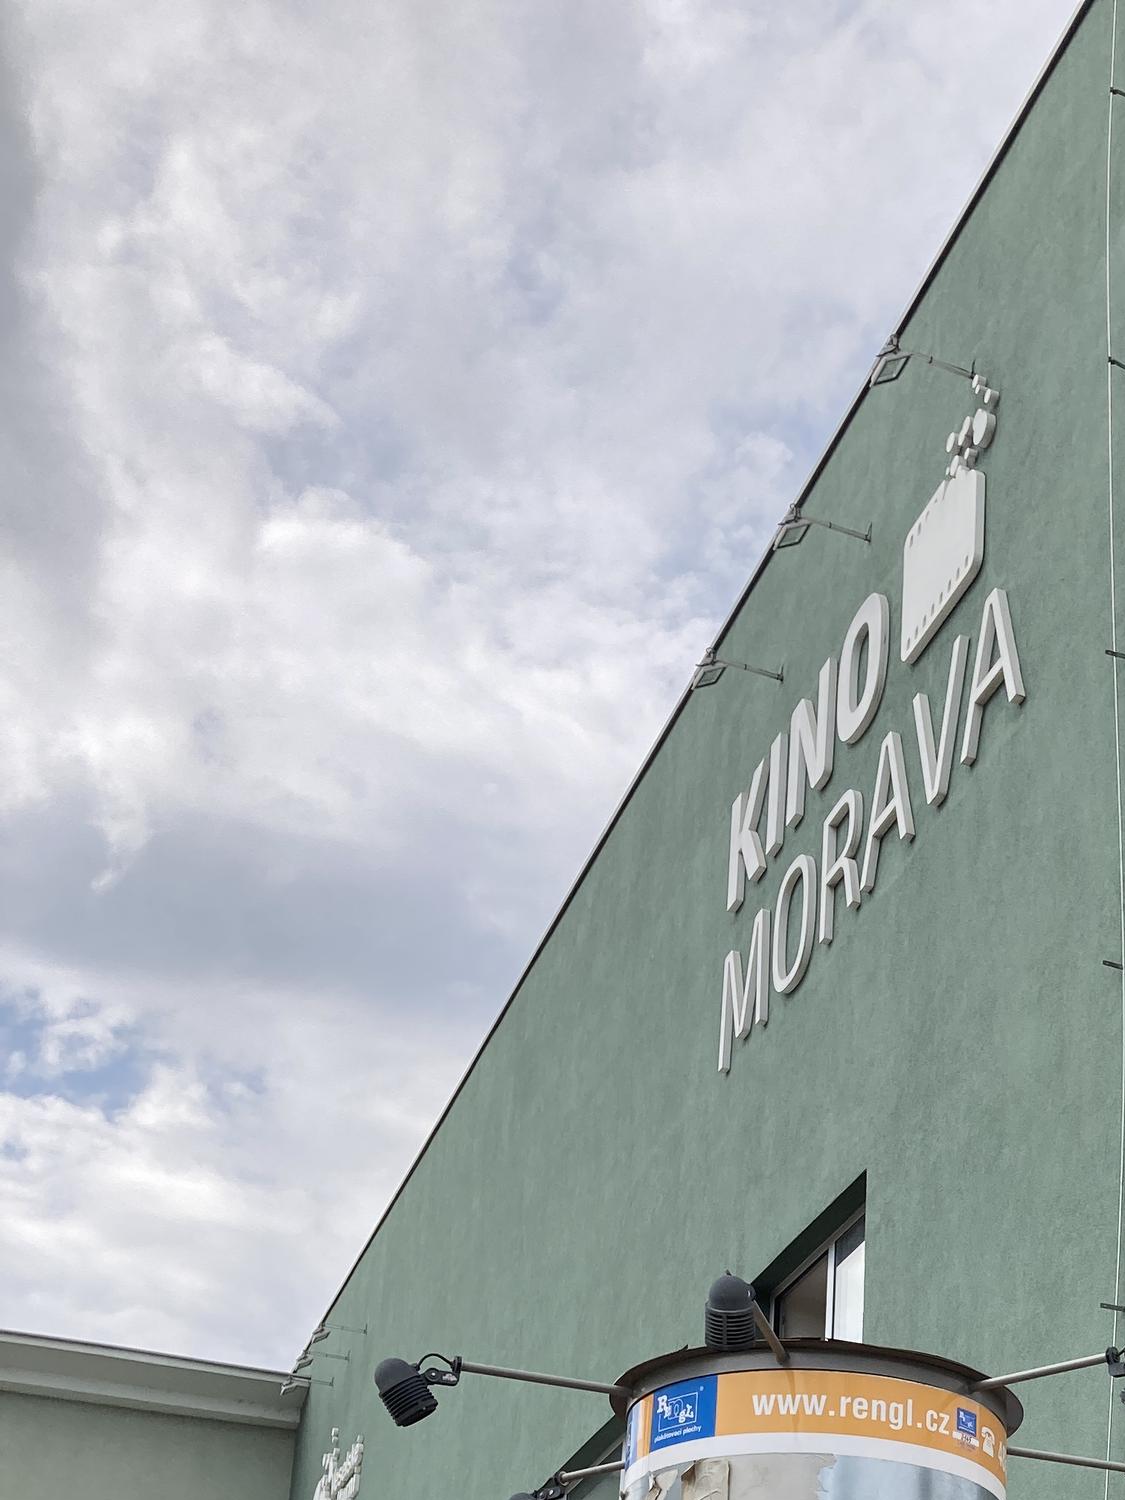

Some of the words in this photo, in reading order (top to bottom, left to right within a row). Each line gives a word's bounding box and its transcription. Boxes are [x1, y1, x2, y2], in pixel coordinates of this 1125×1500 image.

[718, 587, 1026, 1073] MORAVA
[727, 592, 889, 912] KINO
[752, 1394, 950, 1434] www.rengl.cz
